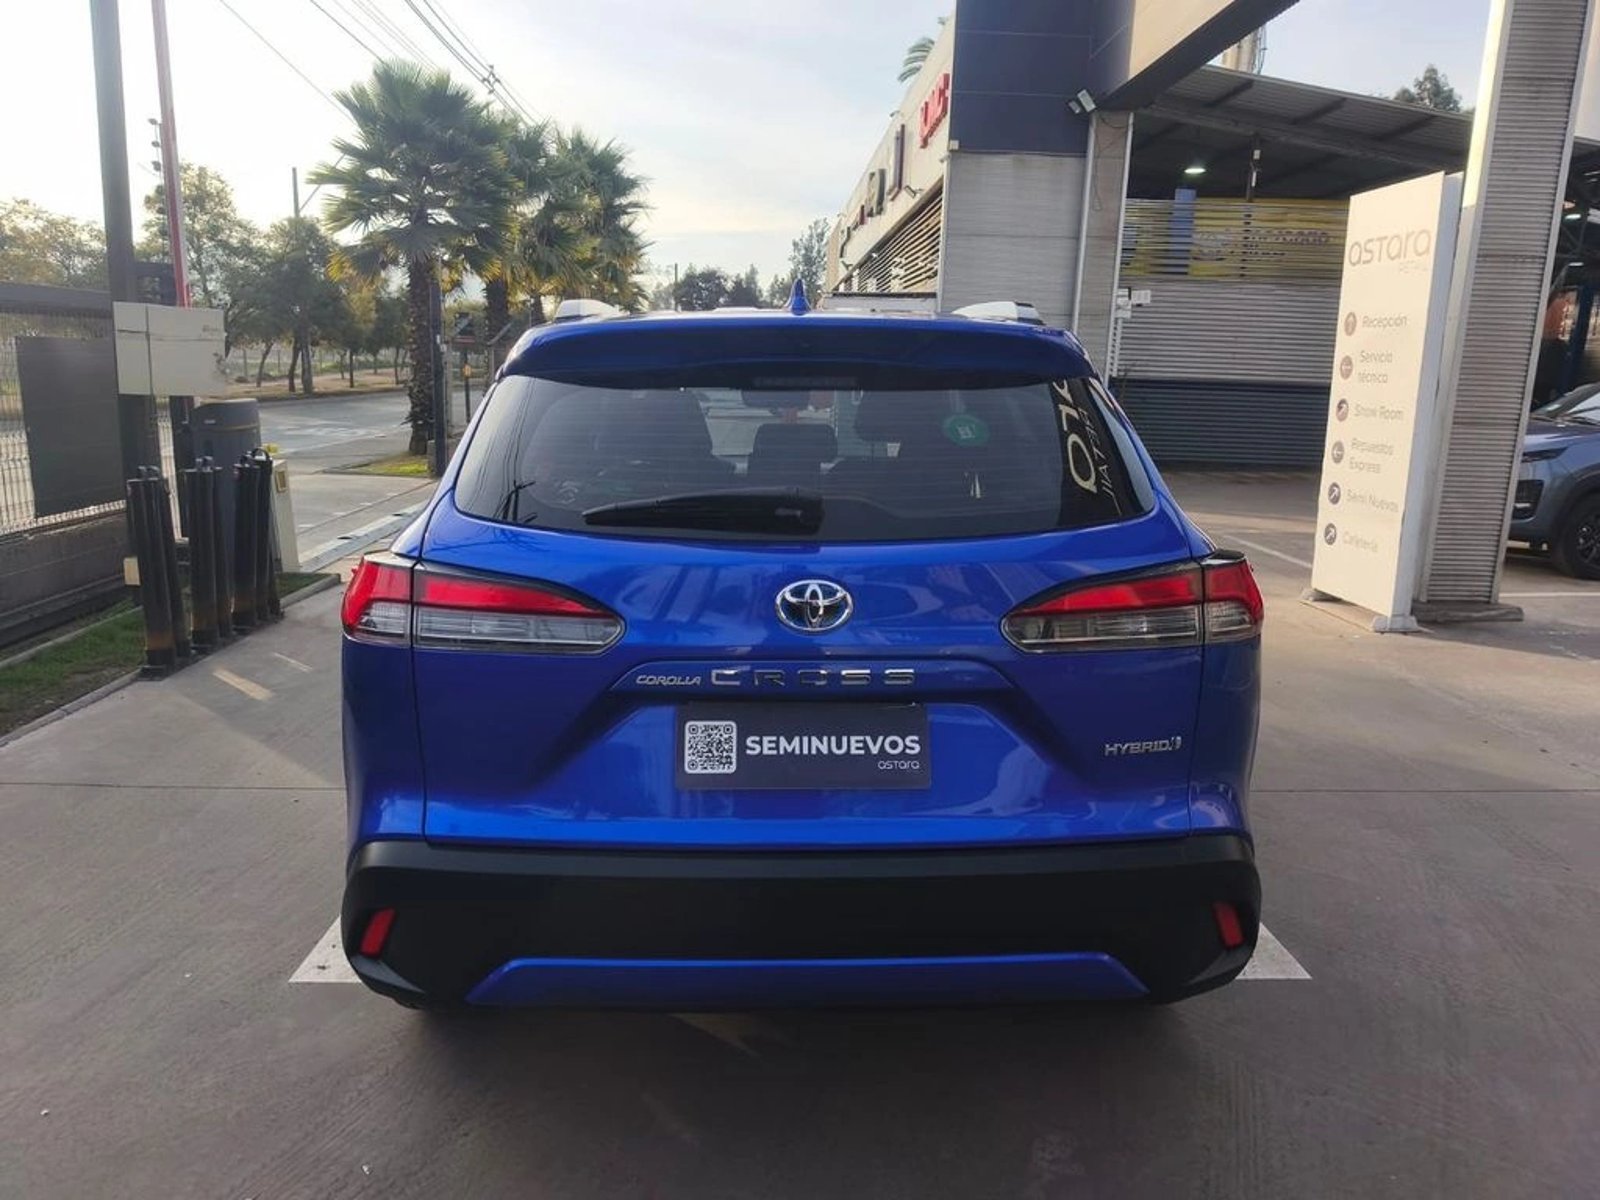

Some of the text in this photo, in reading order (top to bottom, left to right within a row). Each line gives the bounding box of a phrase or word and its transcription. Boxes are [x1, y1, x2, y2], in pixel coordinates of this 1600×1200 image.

[1348, 229, 1431, 267] astara
[1361, 313, 1408, 331] Recepción
[1359, 349, 1393, 363] Servicio
[1378, 406, 1404, 421] Room
[636, 668, 916, 686] COROLLA CROSS
[745, 735, 921, 755] SEMINUEVOS
[1104, 739, 1169, 757] HYBRID
[878, 760, 920, 770] astara
